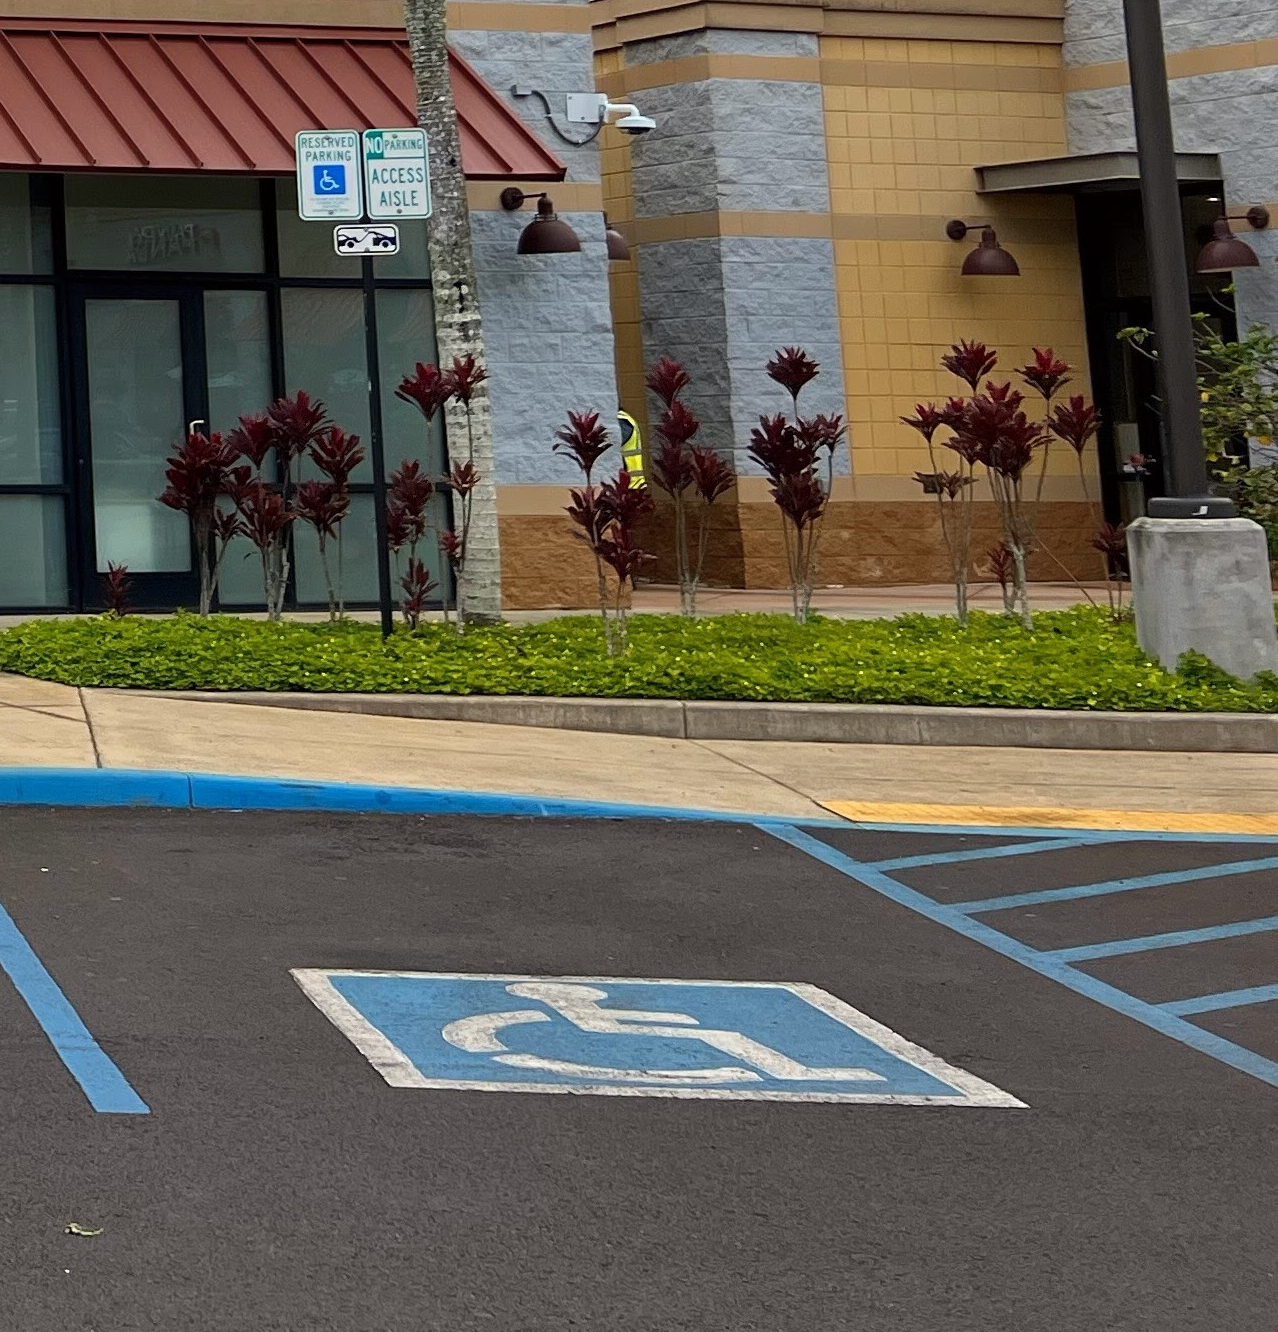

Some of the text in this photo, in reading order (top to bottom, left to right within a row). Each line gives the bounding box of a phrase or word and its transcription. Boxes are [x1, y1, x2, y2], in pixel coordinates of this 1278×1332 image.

[301, 135, 354, 148] RESERVED
[366, 136, 423, 154] NO PARKING
[305, 150, 352, 162] PARKING
[371, 167, 424, 185] ACCESS
[379, 190, 419, 207] AISLE
